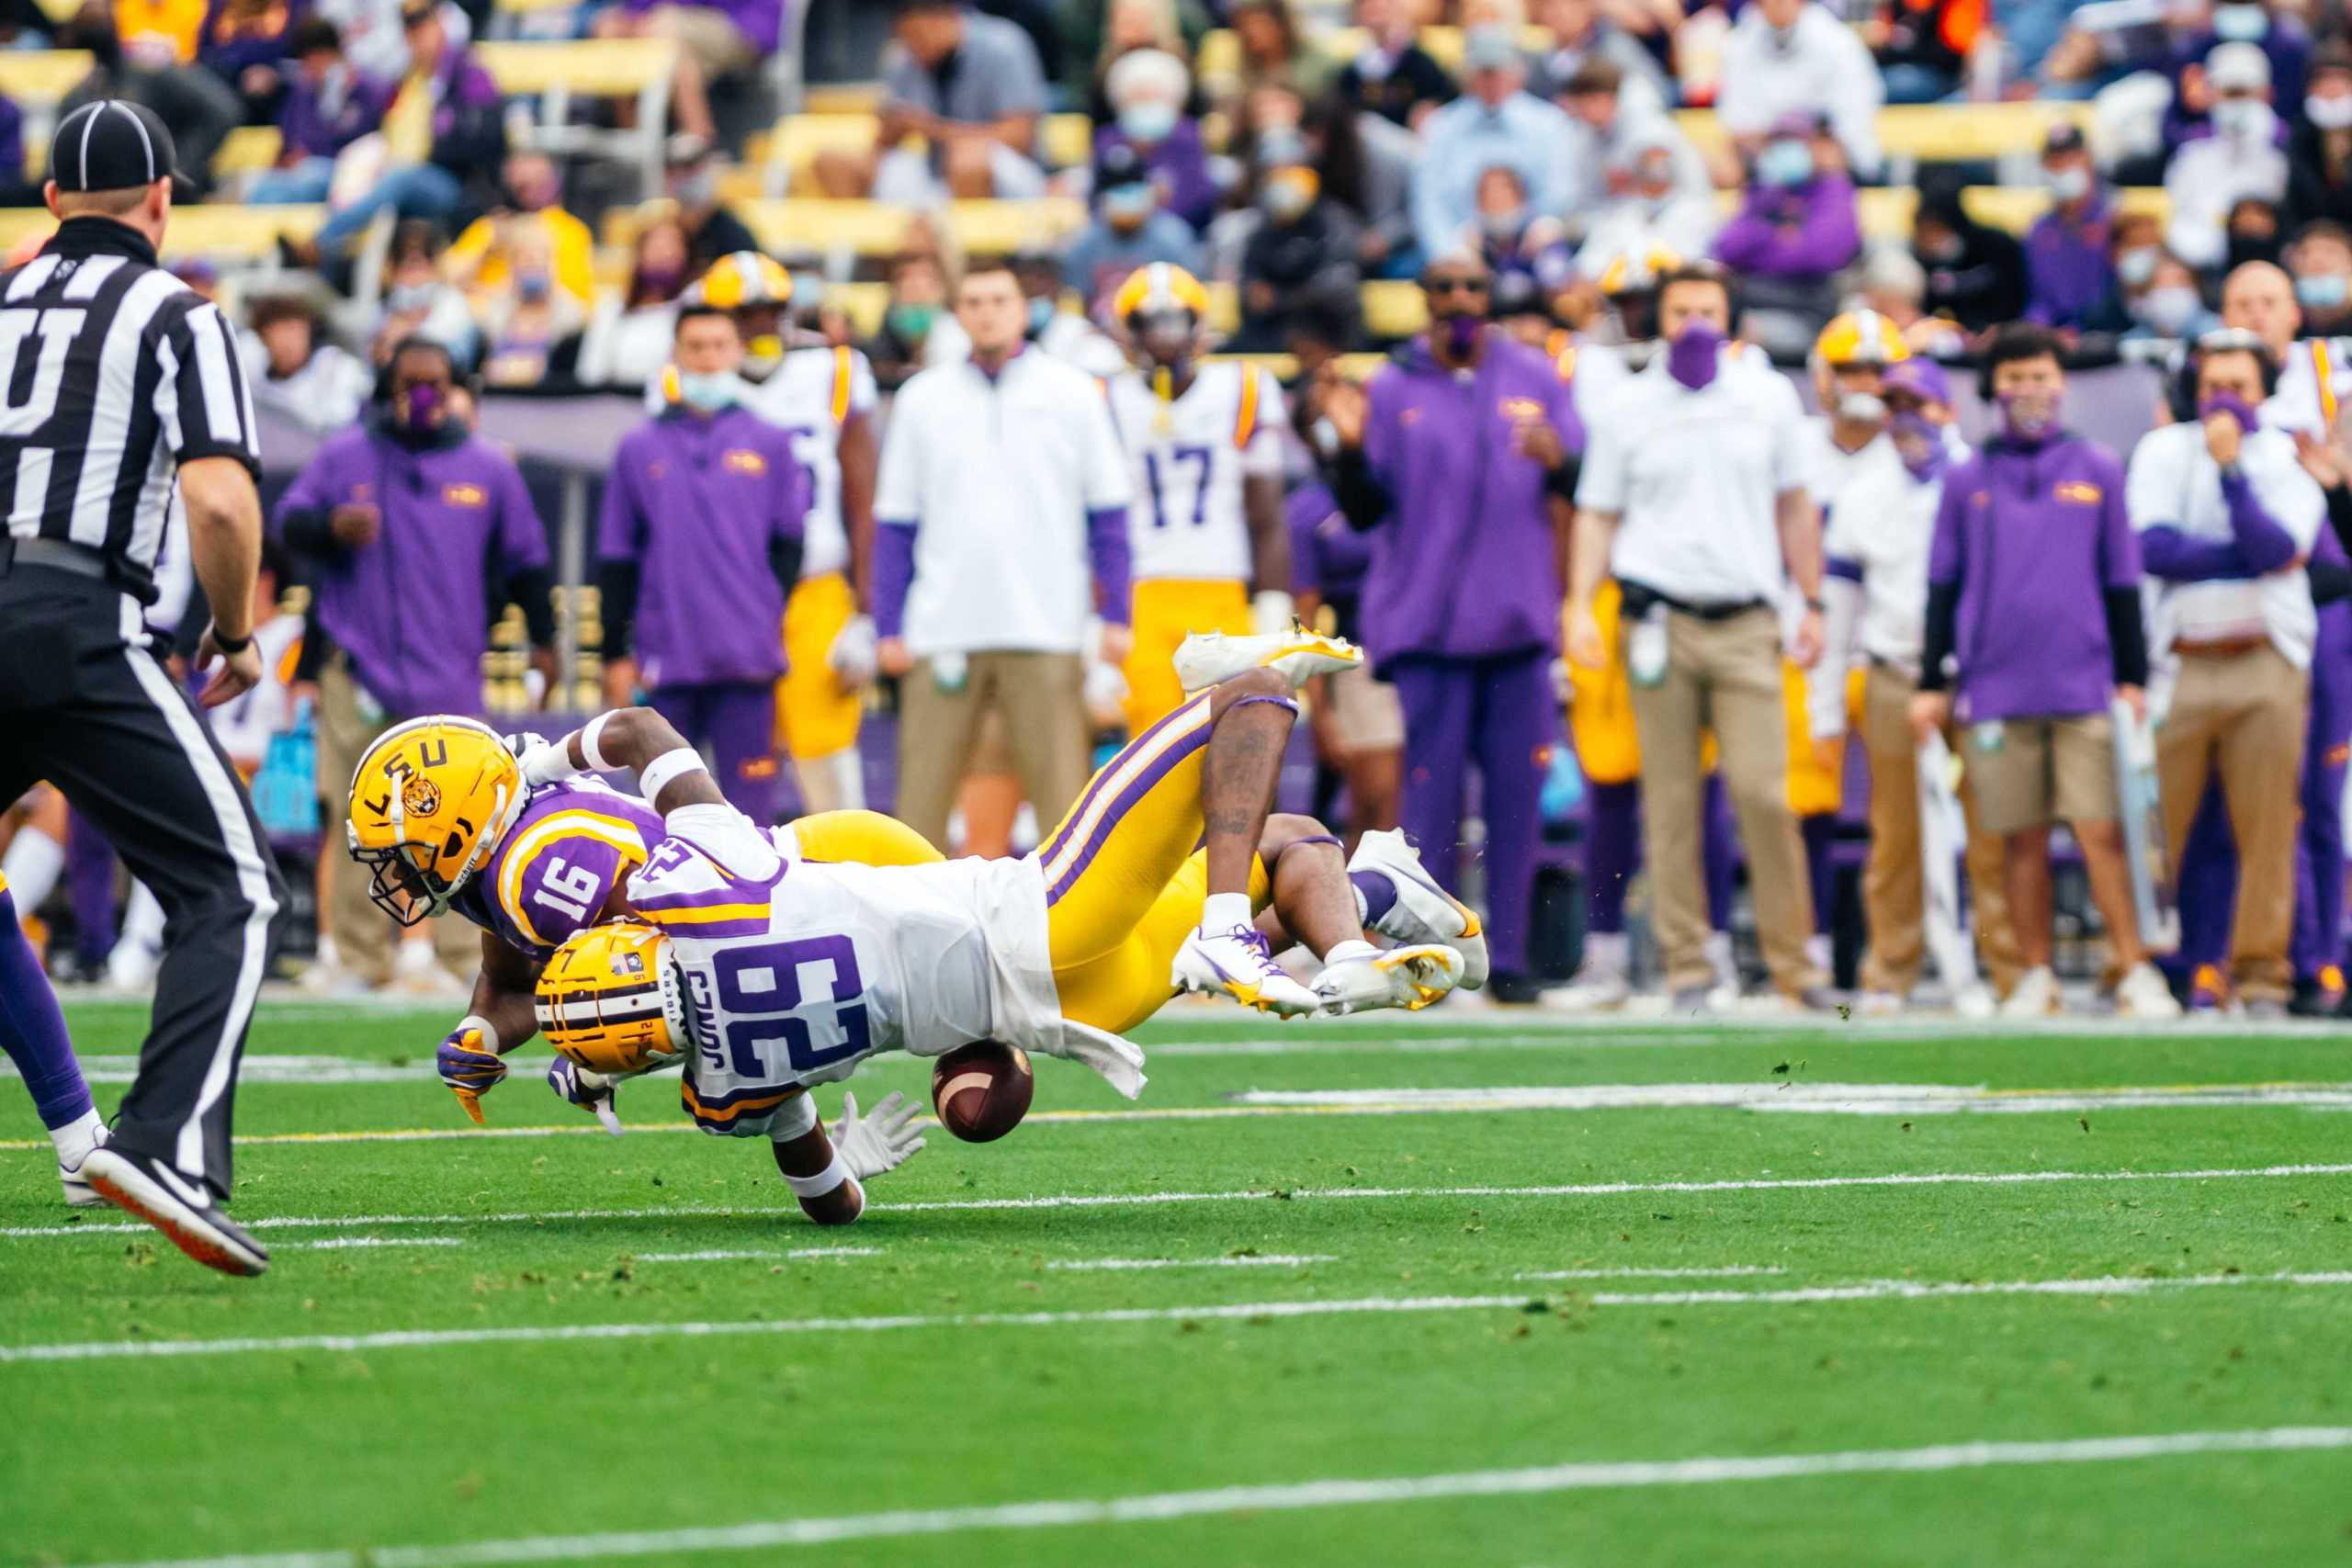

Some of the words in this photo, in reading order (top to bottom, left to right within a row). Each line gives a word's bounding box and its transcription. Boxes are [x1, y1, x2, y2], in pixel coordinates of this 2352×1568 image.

[1146, 446, 1212, 528] 17
[364, 739, 448, 817] LSU
[533, 856, 601, 922] 16
[663, 970, 677, 1022] TIGERS
[686, 970, 725, 1069] JONES
[712, 934, 871, 1078] 29
